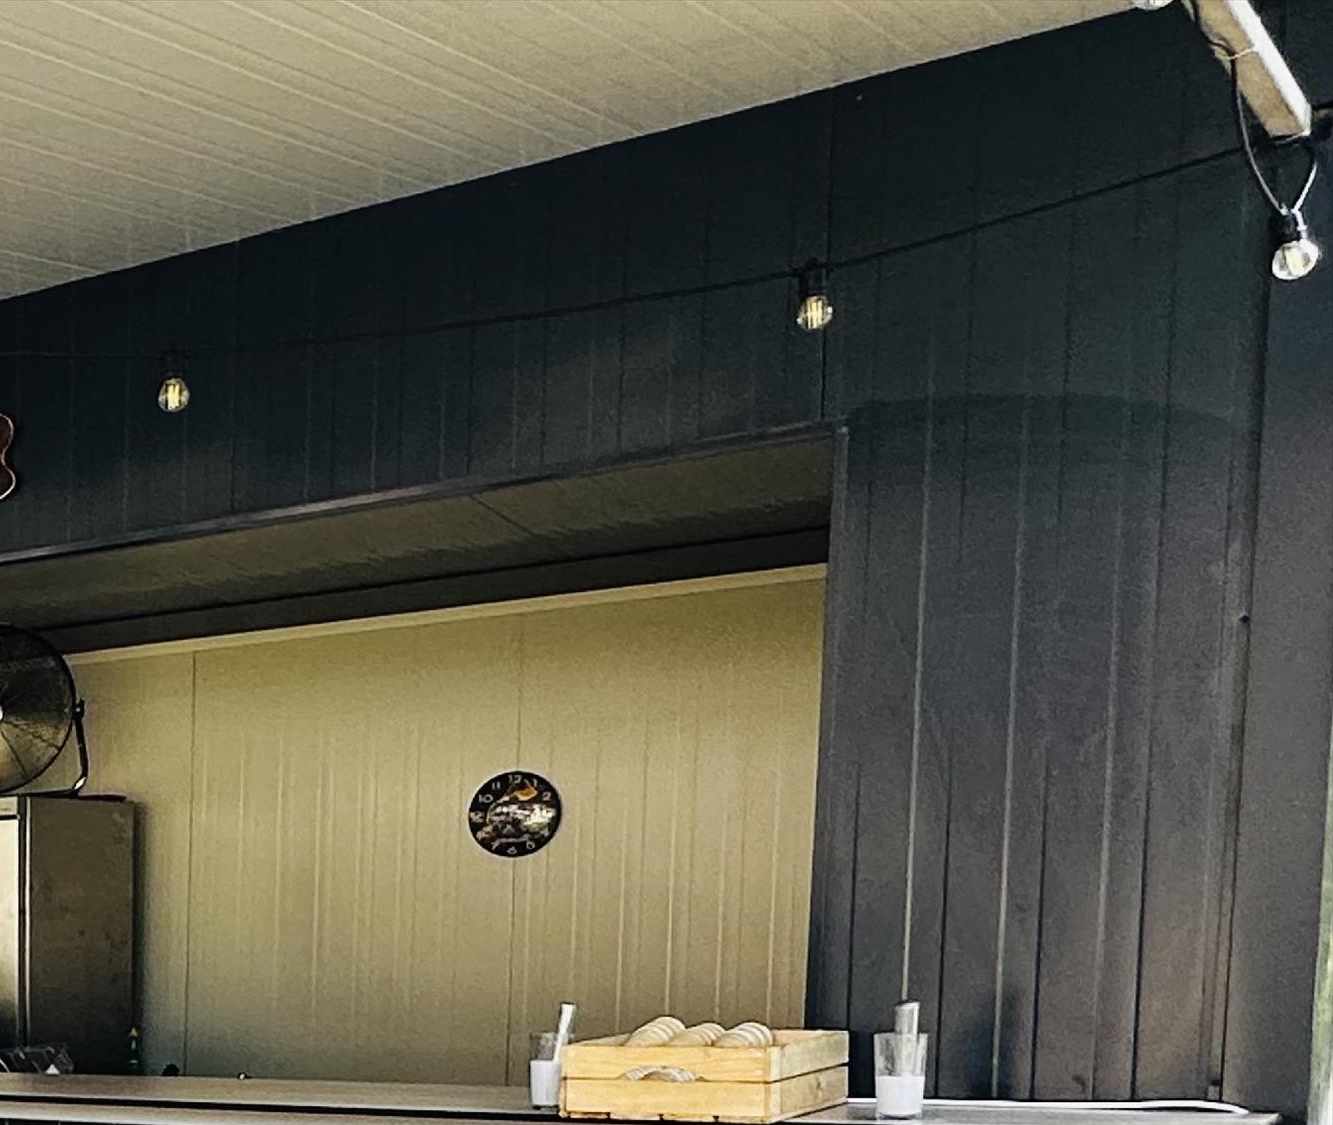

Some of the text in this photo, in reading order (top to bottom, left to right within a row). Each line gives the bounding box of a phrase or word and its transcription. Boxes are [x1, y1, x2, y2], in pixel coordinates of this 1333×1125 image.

[508, 774, 523, 784] 12
[491, 781, 501, 790] 11
[478, 794, 494, 803] 10
[542, 791, 551, 801] 2
